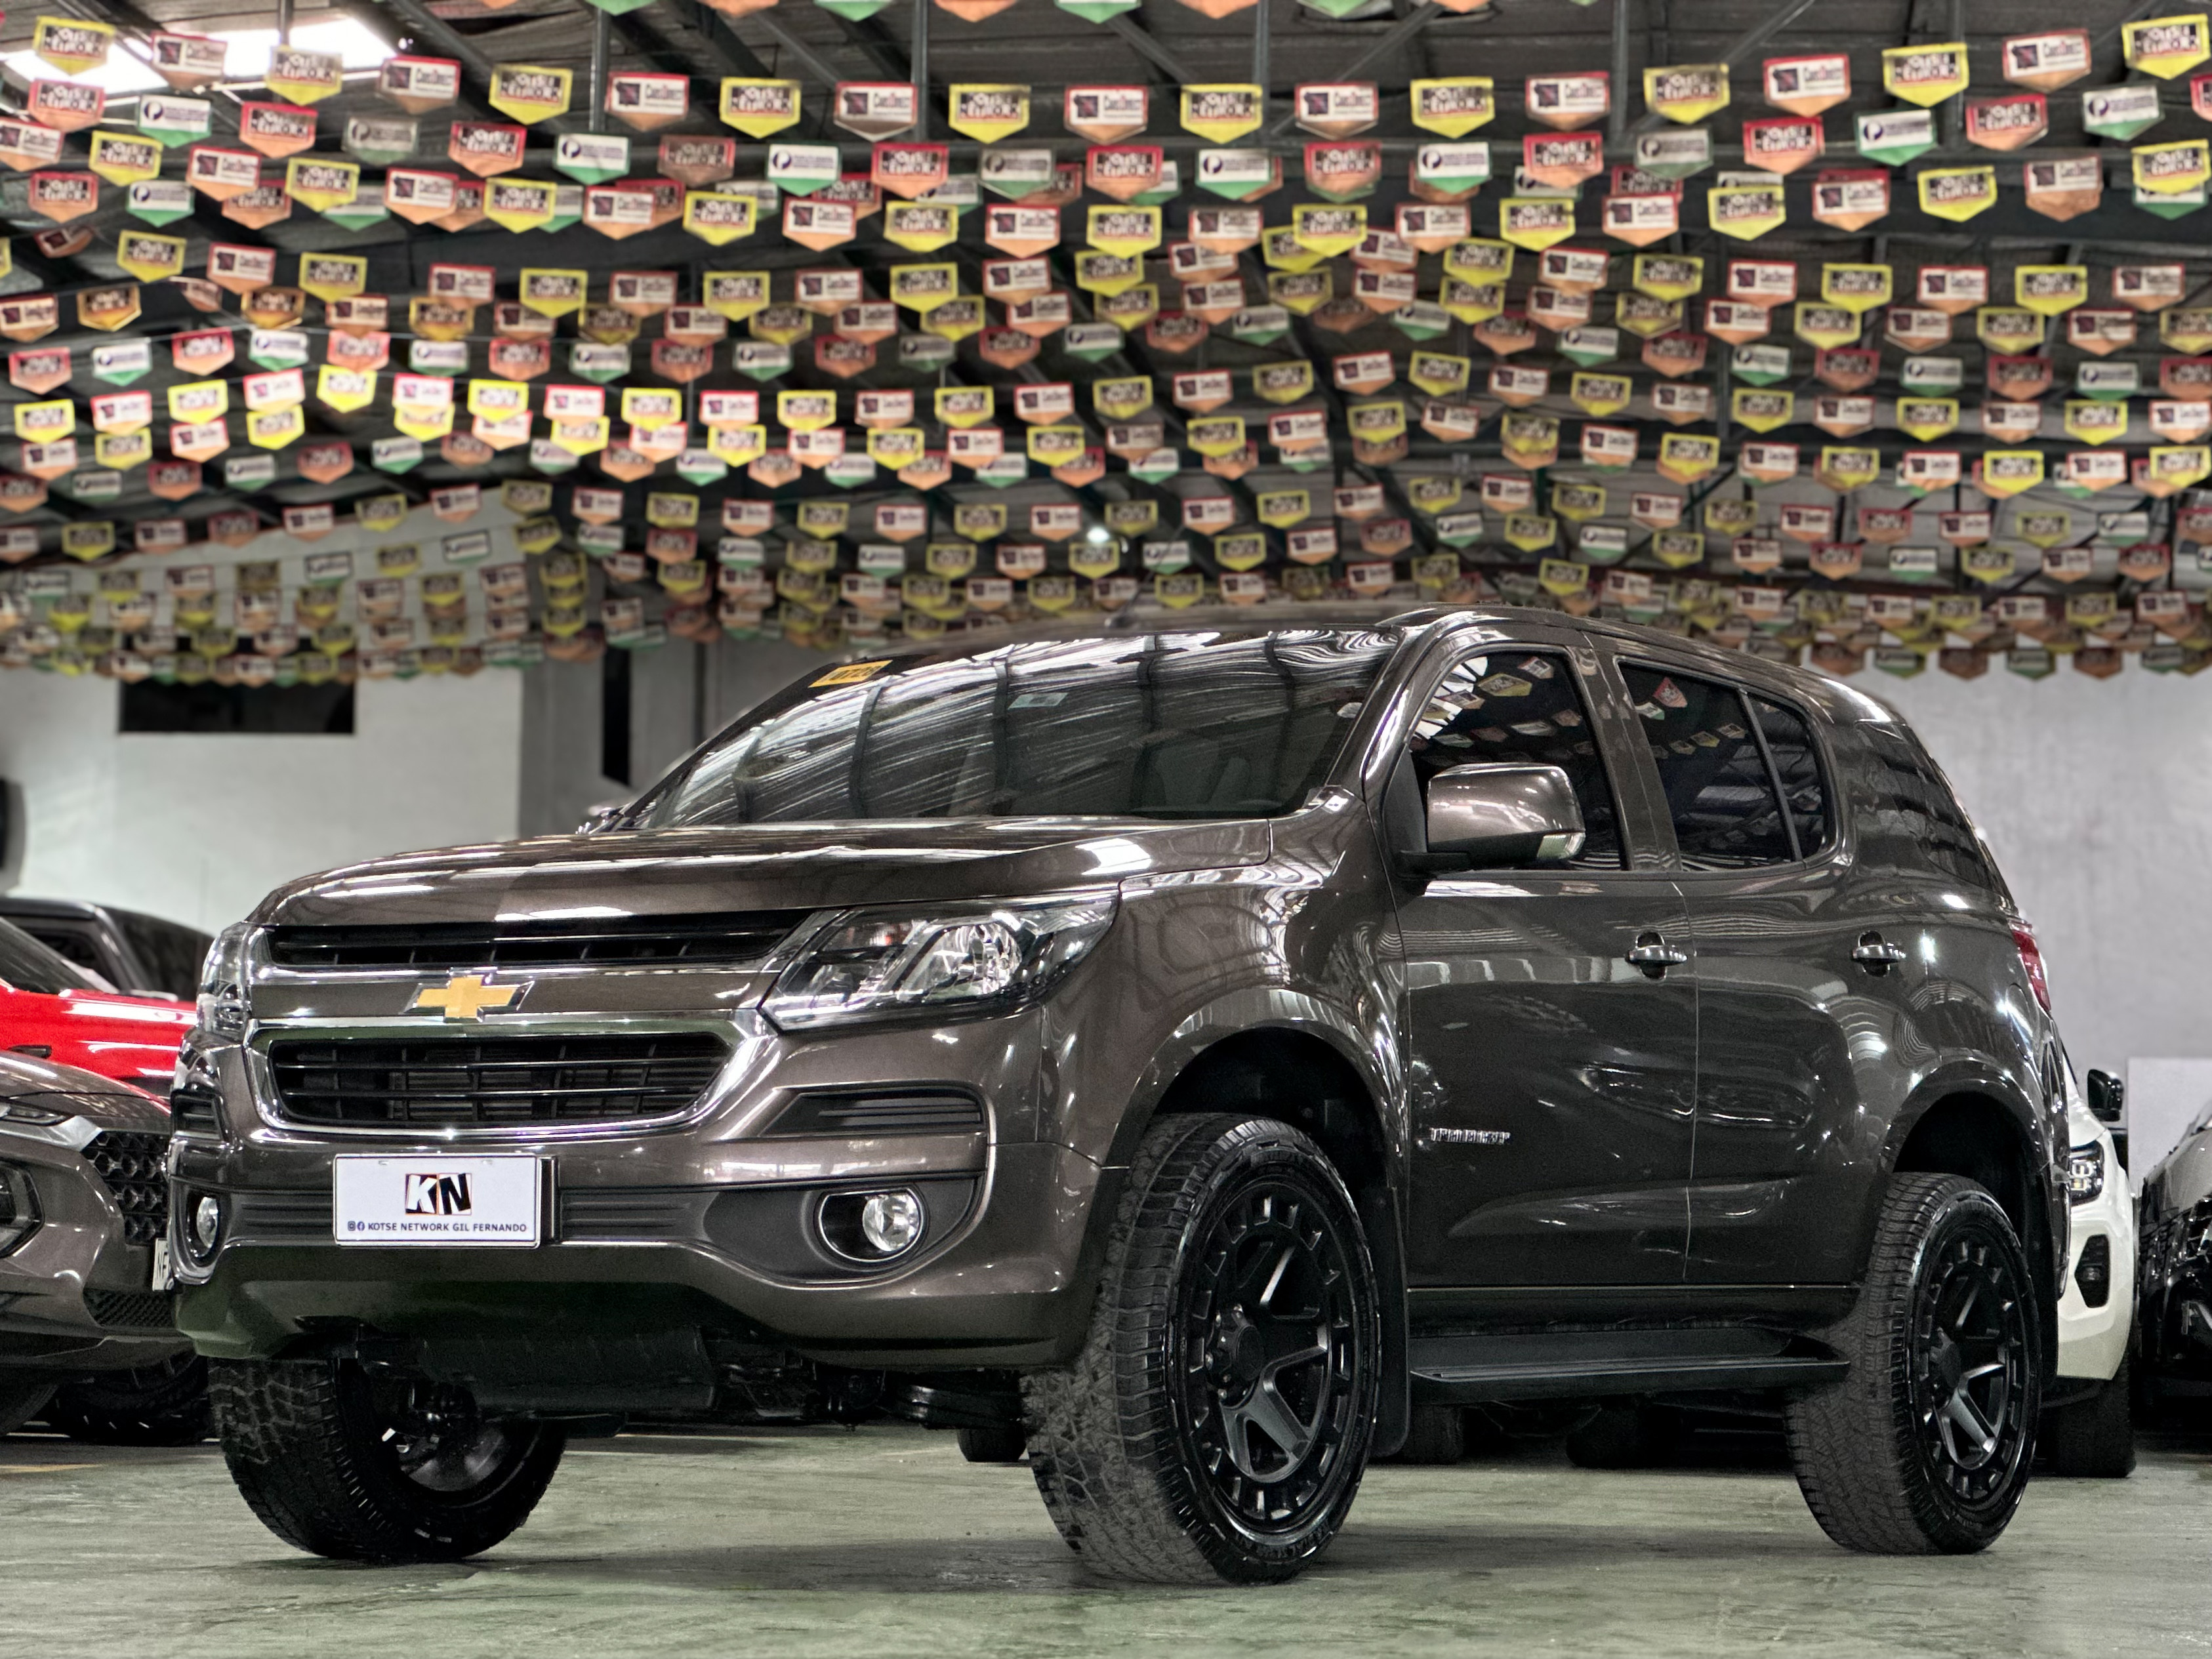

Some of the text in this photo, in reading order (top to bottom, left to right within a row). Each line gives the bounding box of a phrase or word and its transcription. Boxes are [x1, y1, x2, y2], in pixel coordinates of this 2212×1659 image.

[405, 1173, 472, 1216] KN
[367, 1222, 527, 1233] KOTSE NETWORK GIL FERNANDO
